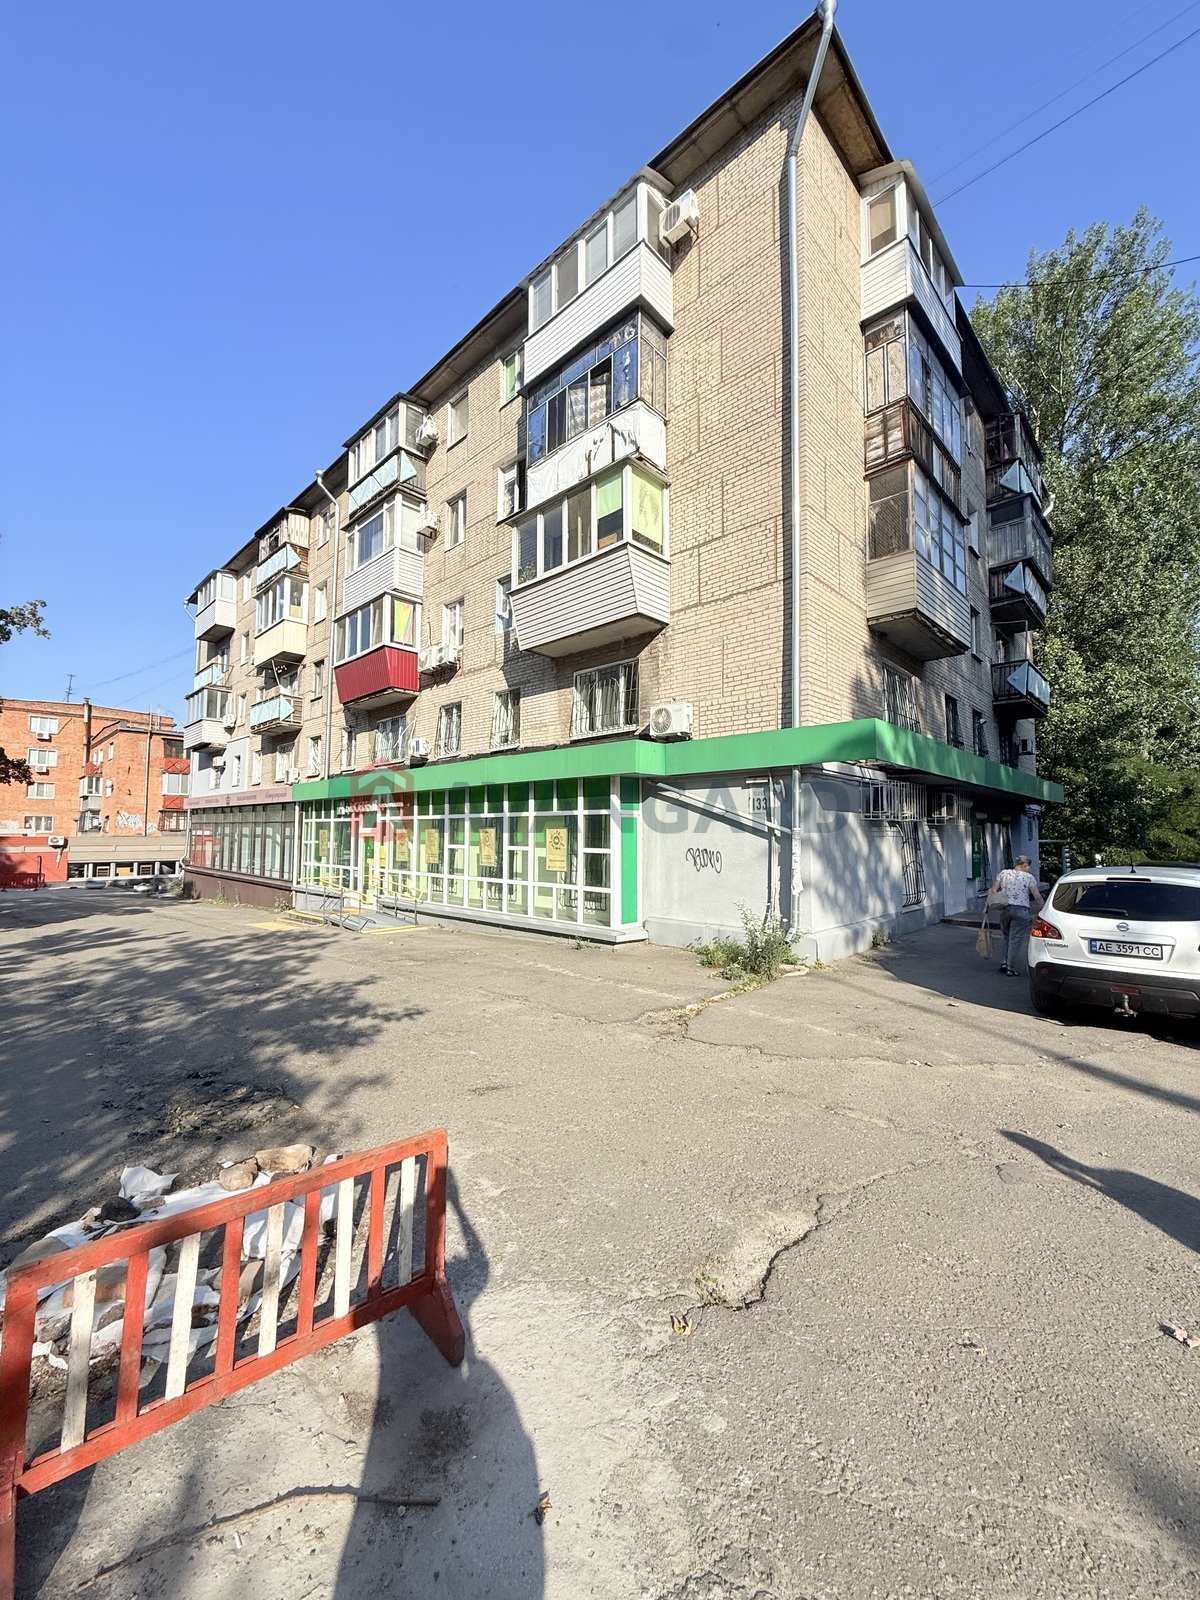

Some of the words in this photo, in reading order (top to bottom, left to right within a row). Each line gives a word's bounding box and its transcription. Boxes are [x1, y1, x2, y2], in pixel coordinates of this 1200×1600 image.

[752, 797, 768, 811] 133
[1098, 942, 1113, 953] AE
[1116, 944, 1140, 955] 3591
[1143, 947, 1160, 957] CC
